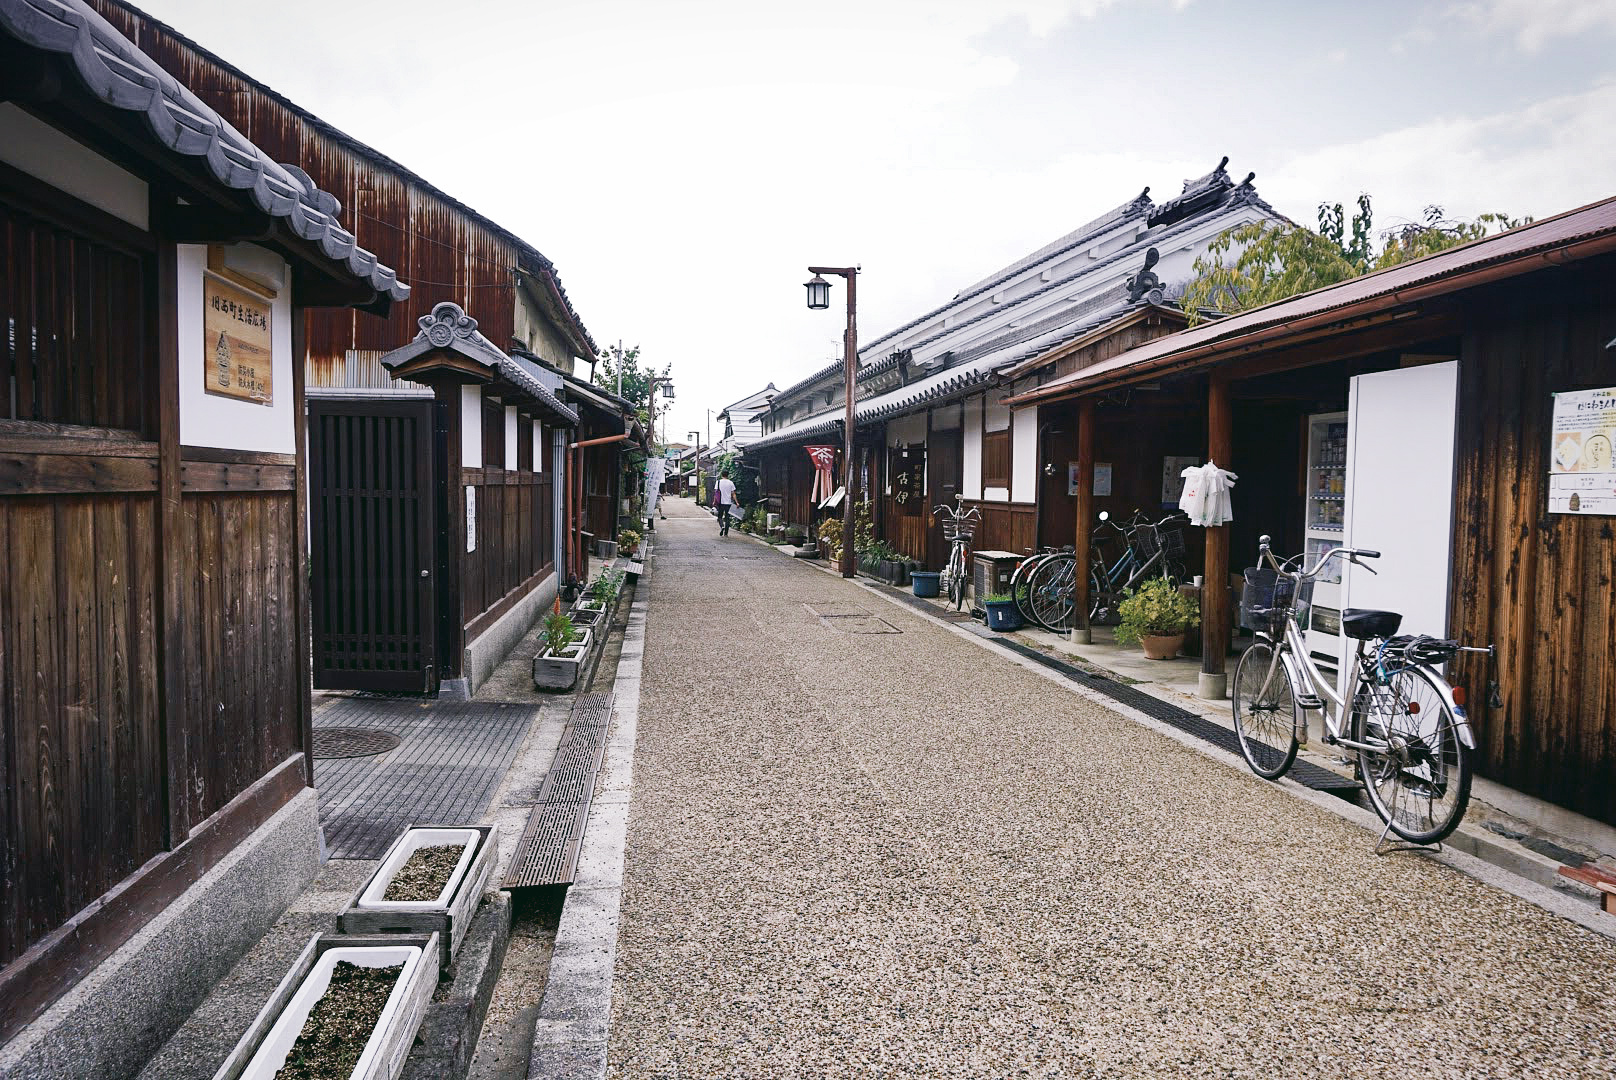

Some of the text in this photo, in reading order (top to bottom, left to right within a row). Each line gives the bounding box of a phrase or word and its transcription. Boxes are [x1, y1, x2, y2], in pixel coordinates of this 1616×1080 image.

[212, 295, 267, 331] 旧西町生活広場
[810, 447, 834, 464] 茶
[895, 471, 909, 505] 古伊
